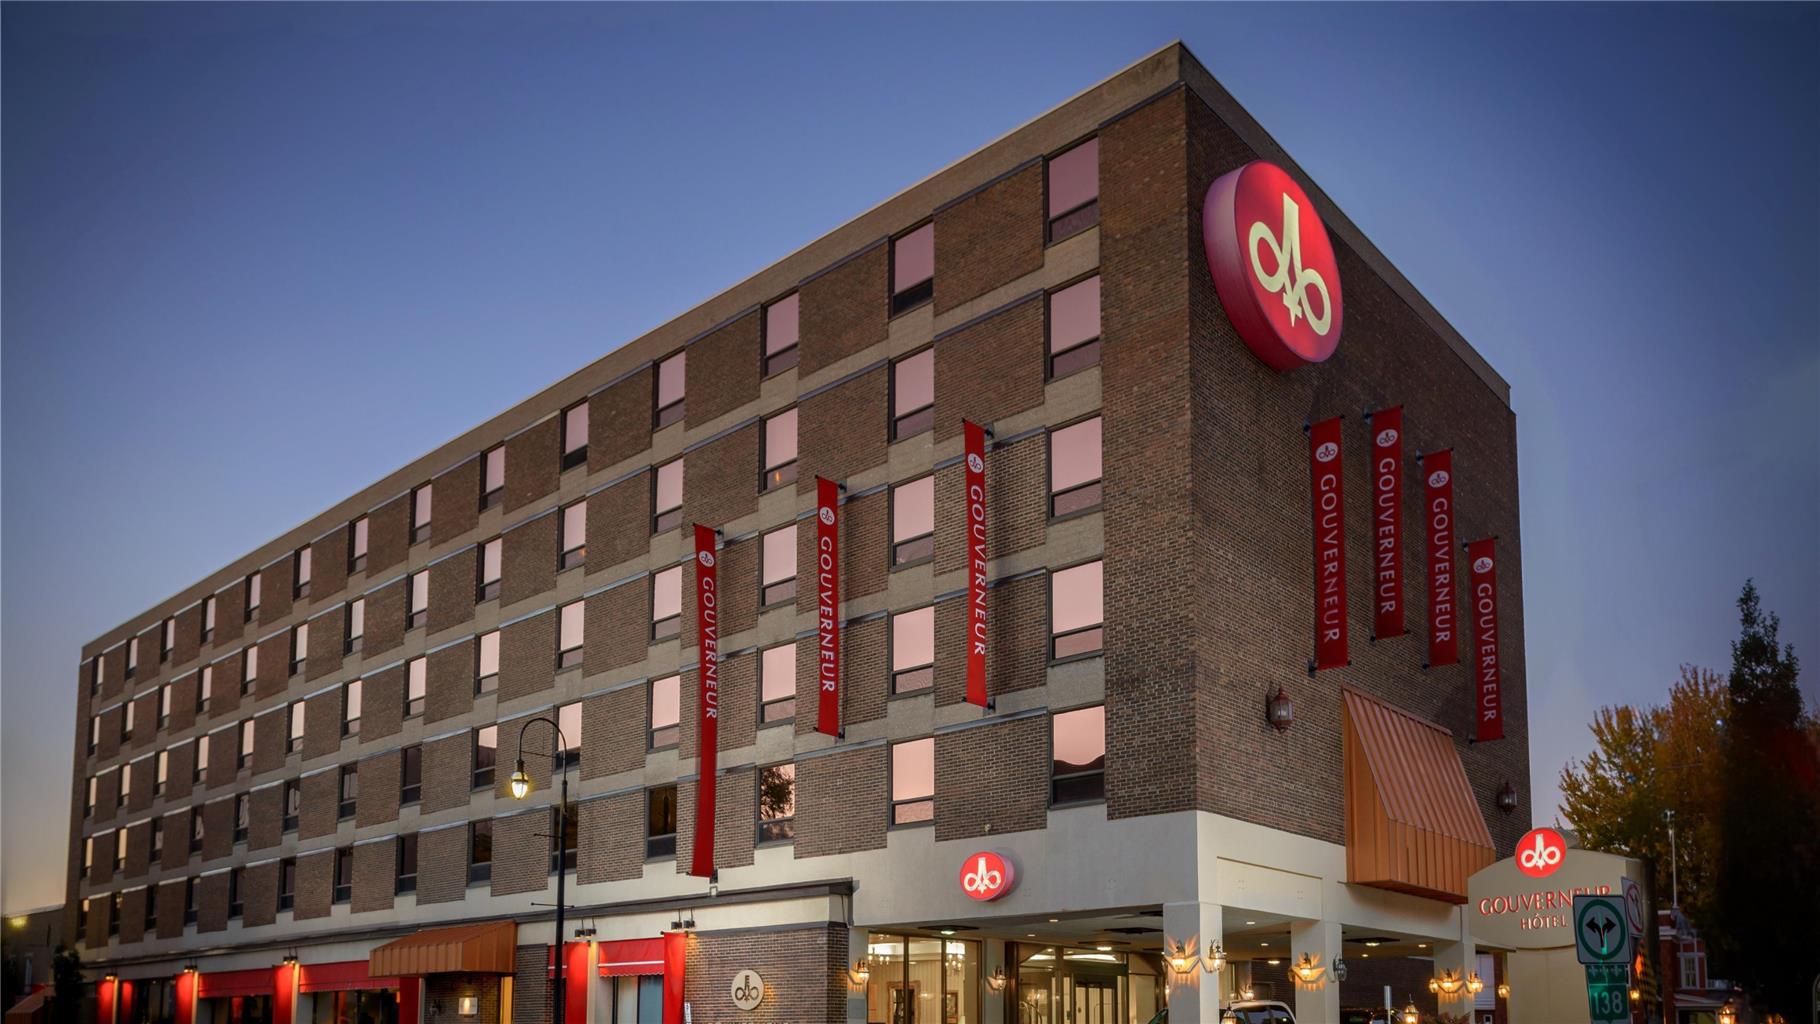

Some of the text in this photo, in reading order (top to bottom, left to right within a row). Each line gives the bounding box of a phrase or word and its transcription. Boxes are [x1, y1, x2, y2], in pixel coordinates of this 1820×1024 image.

[970, 484, 987, 656] GOUVERNEUR
[1320, 474, 1340, 643] GOUVERNEUR
[1379, 457, 1396, 614] GOUVERNEUR
[1433, 497, 1451, 643] GOUVERNEUR
[702, 576, 718, 719] GOUVERNEUR
[820, 536, 835, 693] GOUVERNEUR
[1477, 583, 1497, 722] GOUVERNEUR
[1520, 912, 1568, 930] HÔTEL
[1593, 991, 1624, 1015] 138
